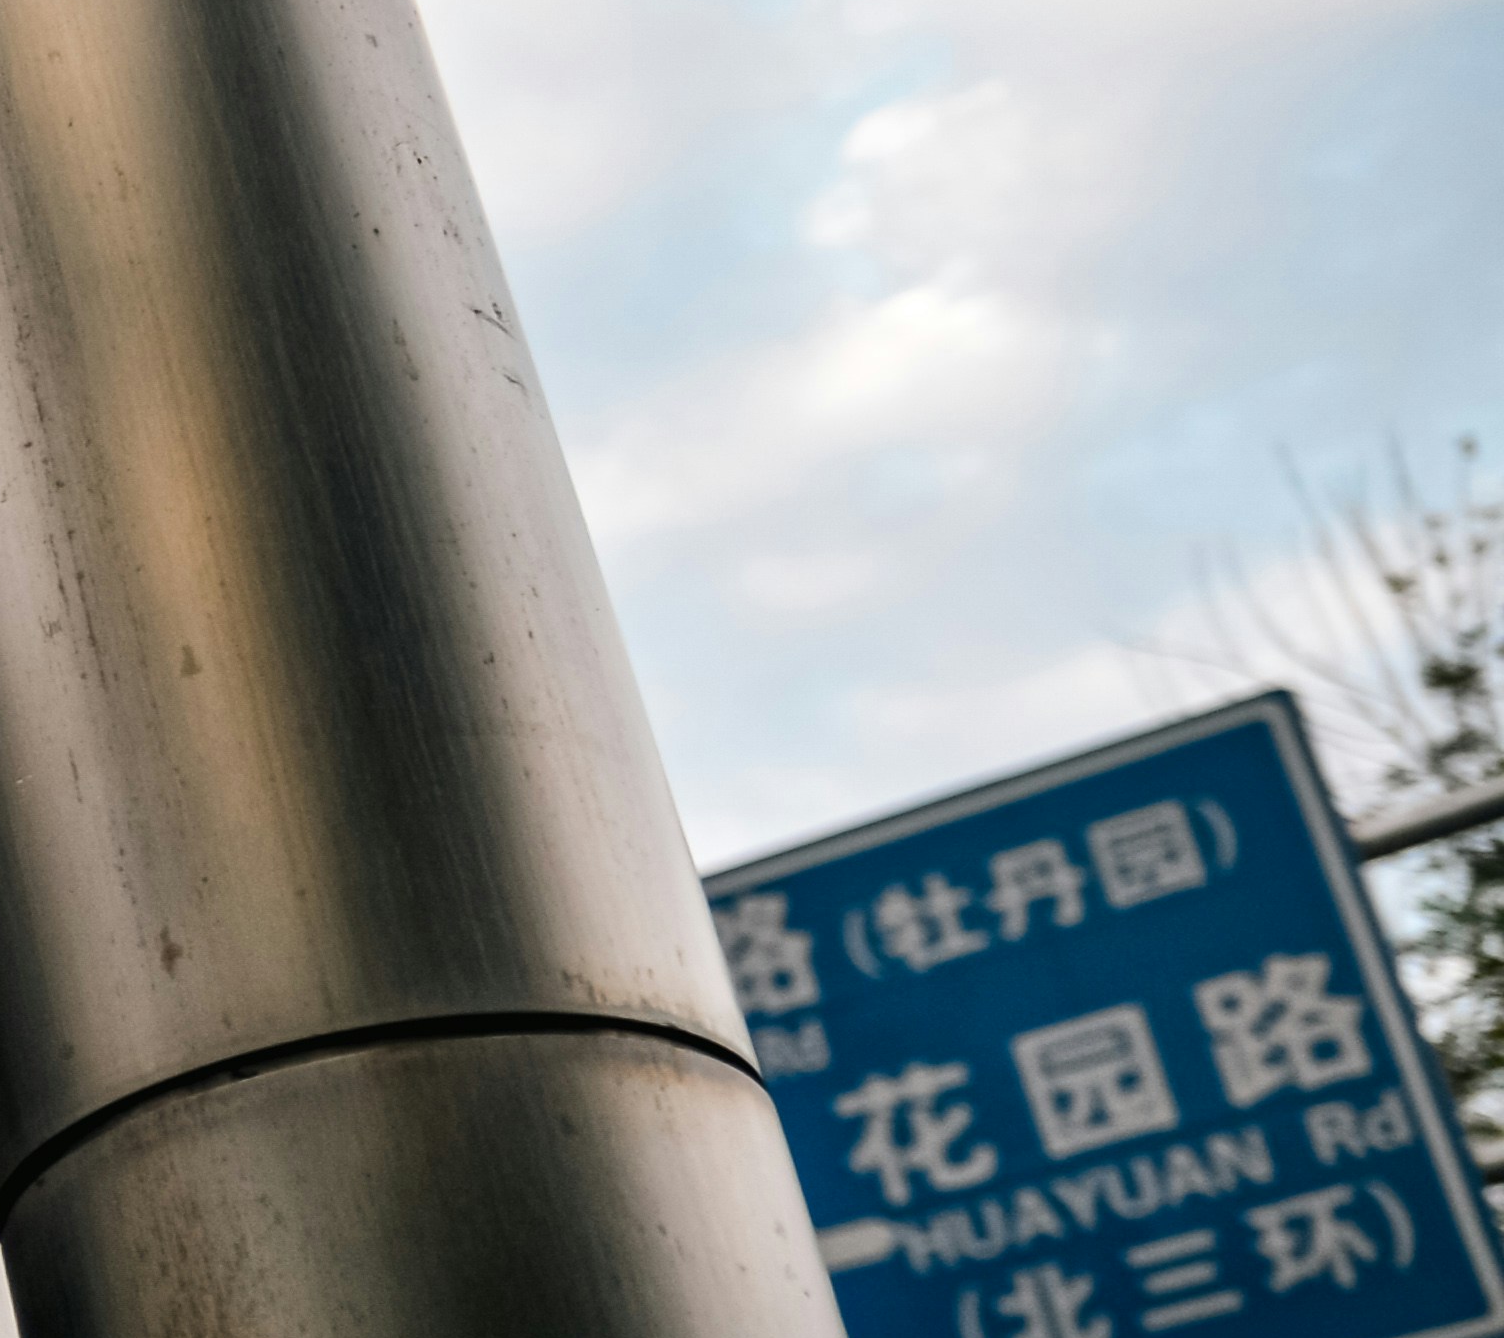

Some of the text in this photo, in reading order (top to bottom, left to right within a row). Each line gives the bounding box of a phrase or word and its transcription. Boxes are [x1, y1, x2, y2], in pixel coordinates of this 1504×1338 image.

[833, 952, 1373, 1206] 花园路
[1303, 1088, 1413, 1166] Rd
